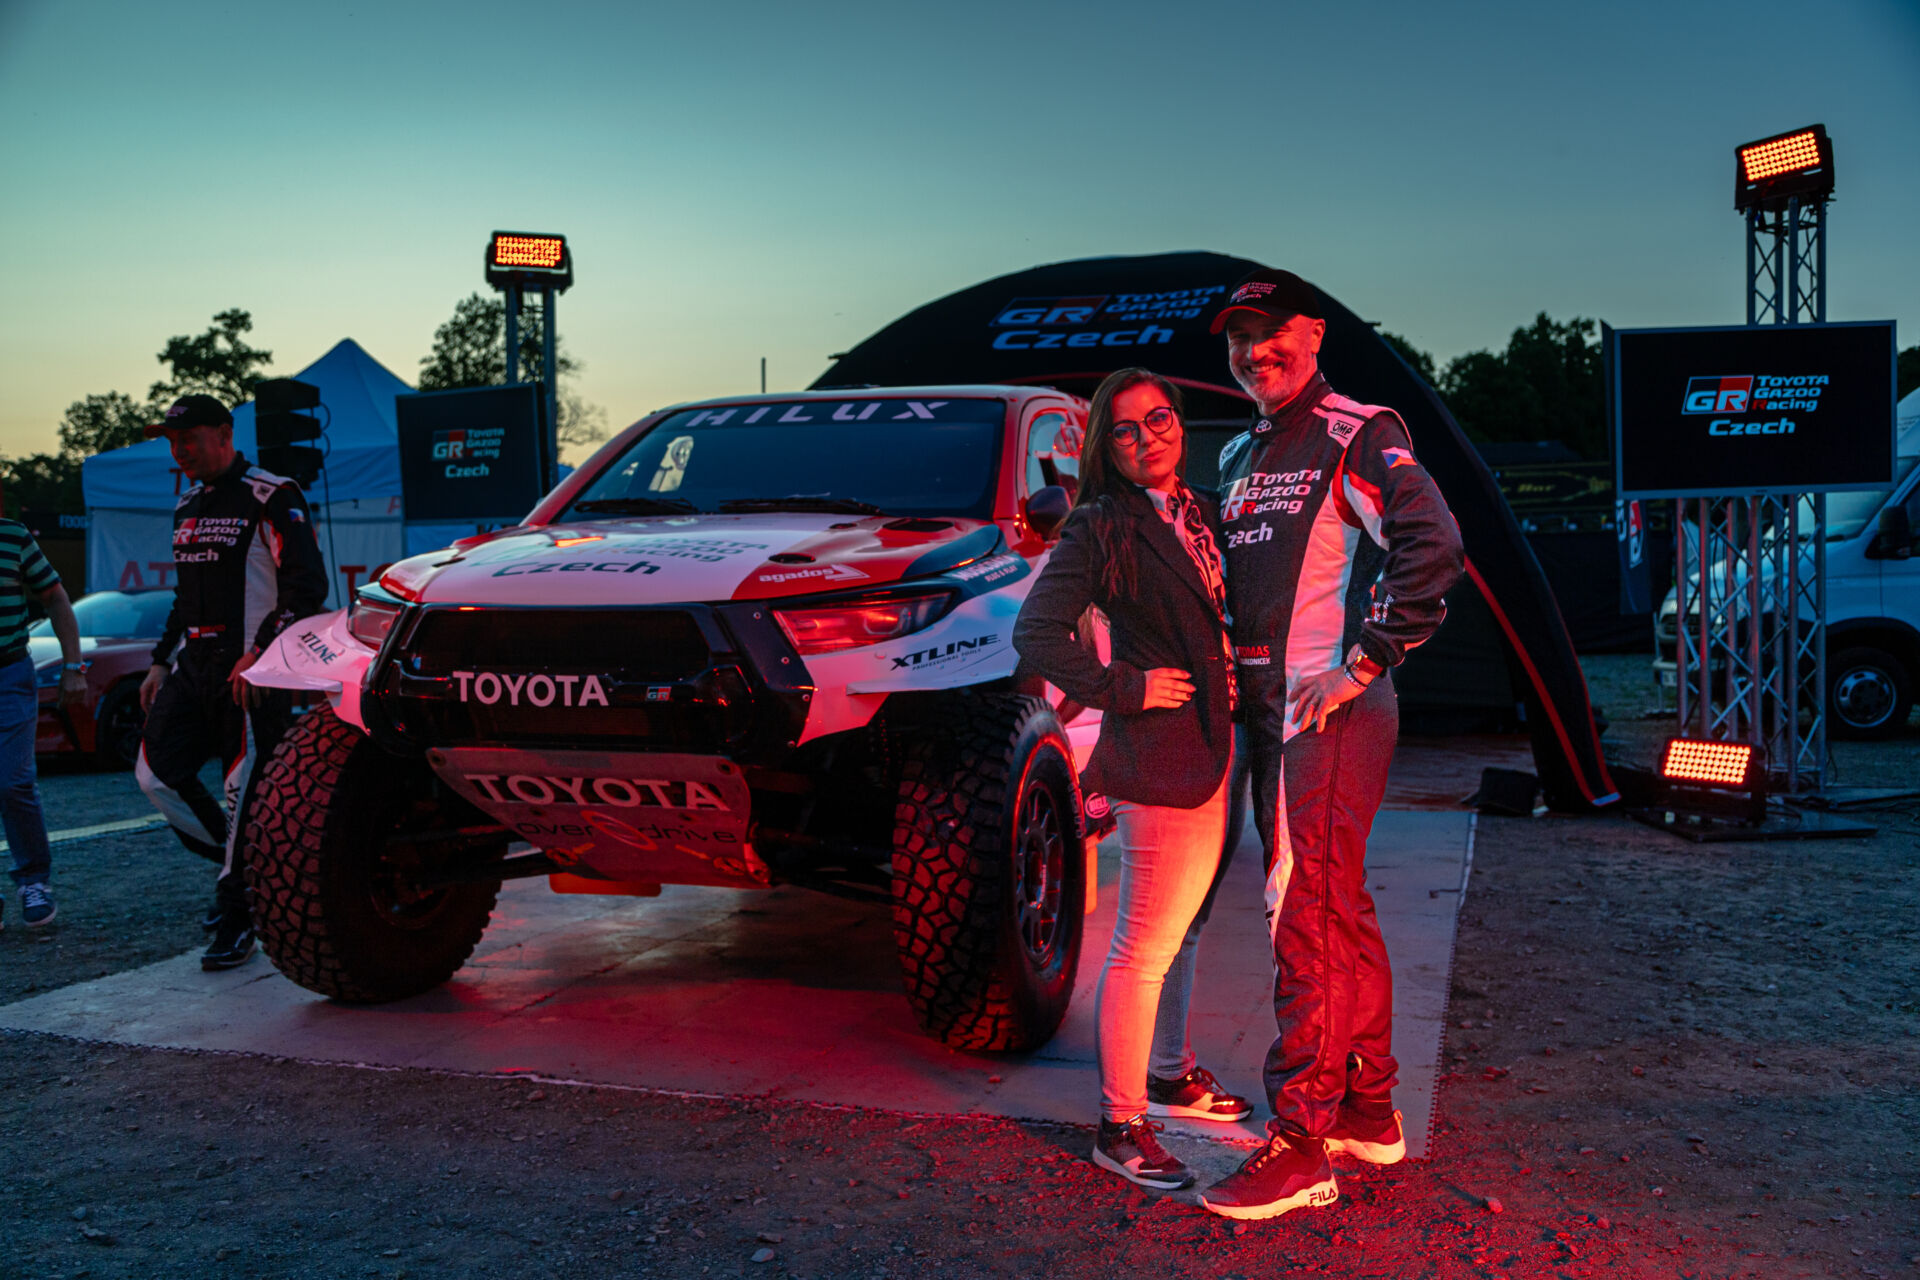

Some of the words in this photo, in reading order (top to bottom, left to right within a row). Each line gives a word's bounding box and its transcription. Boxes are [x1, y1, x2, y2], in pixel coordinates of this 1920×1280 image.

[1115, 285, 1226, 303] TOYOTA
[1105, 296, 1211, 313] GAZOO
[997, 305, 1095, 325] GR
[1098, 306, 1203, 321] Racing
[992, 324, 1175, 350] Czech
[1756, 374, 1830, 388] TOYOTA
[1685, 389, 1749, 412] GR
[1753, 387, 1822, 400] GAZOO
[685, 401, 950, 428] HILUX
[1752, 399, 1819, 413] Racing
[467, 427, 506, 439] TOYOTA
[1332, 421, 1354, 437] OMP
[1708, 417, 1797, 437] Czech
[432, 440, 465, 460] GR
[444, 463, 491, 479] Czech
[1251, 469, 1322, 486] TOYOTA
[1244, 484, 1312, 500] GAZOO
[1241, 498, 1305, 515] Racing
[491, 561, 661, 577] Czech
[758, 568, 834, 583] agados
[297, 630, 338, 665] XTLINE
[890, 633, 999, 671] XTLINE
[452, 670, 610, 708] TOYOTA
[464, 773, 732, 812] TOYOTA
[1309, 1187, 1337, 1205] FILA
